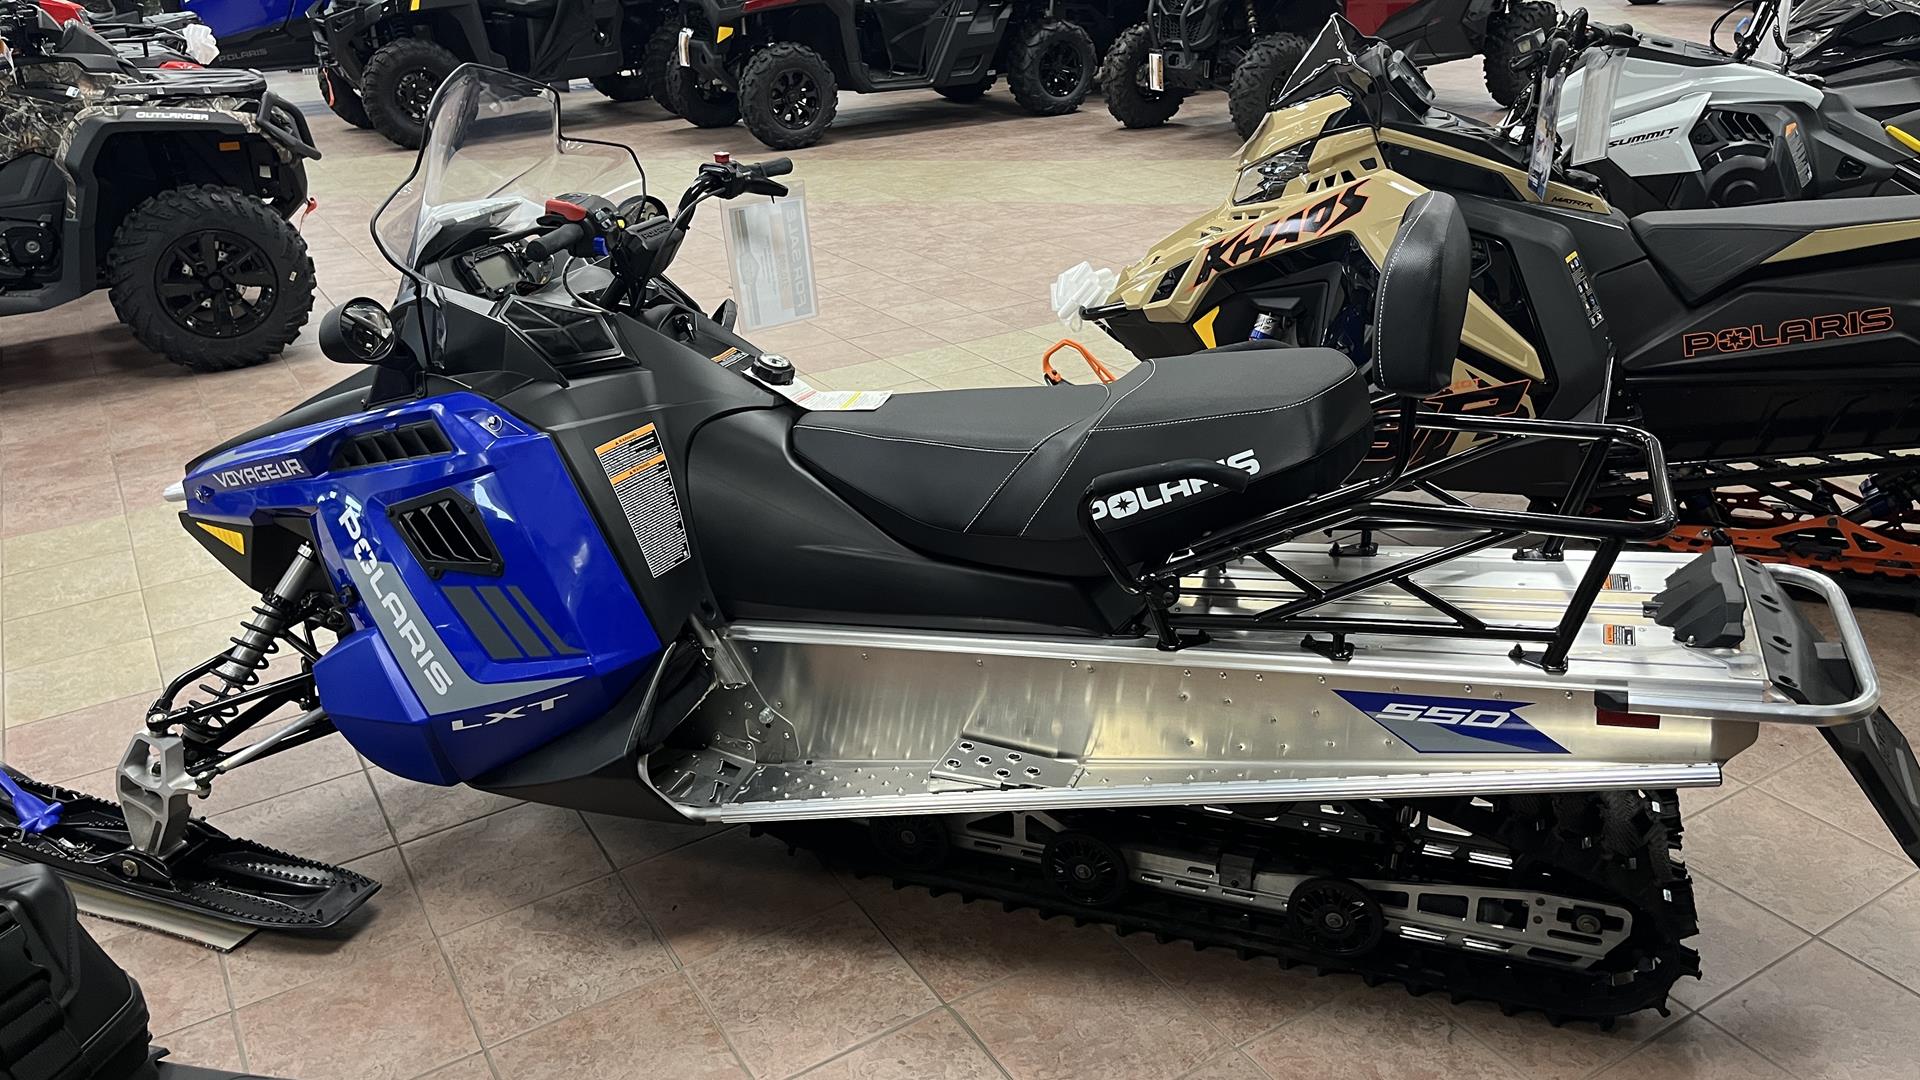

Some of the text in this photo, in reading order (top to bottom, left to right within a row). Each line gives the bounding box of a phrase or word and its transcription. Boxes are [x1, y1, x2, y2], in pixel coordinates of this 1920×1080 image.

[218, 48, 268, 62] POLARIS
[135, 111, 209, 121] OUTLANDER
[1607, 126, 1680, 149] SUMMIT
[1187, 178, 1372, 290] KHAOS
[1682, 306, 1895, 358] POLARIS
[212, 459, 305, 487] VOYAGEUR
[1091, 449, 1261, 521] POLAS
[338, 504, 454, 696] POLARIS
[451, 693, 569, 732] LXT
[1375, 702, 1511, 729] 550
